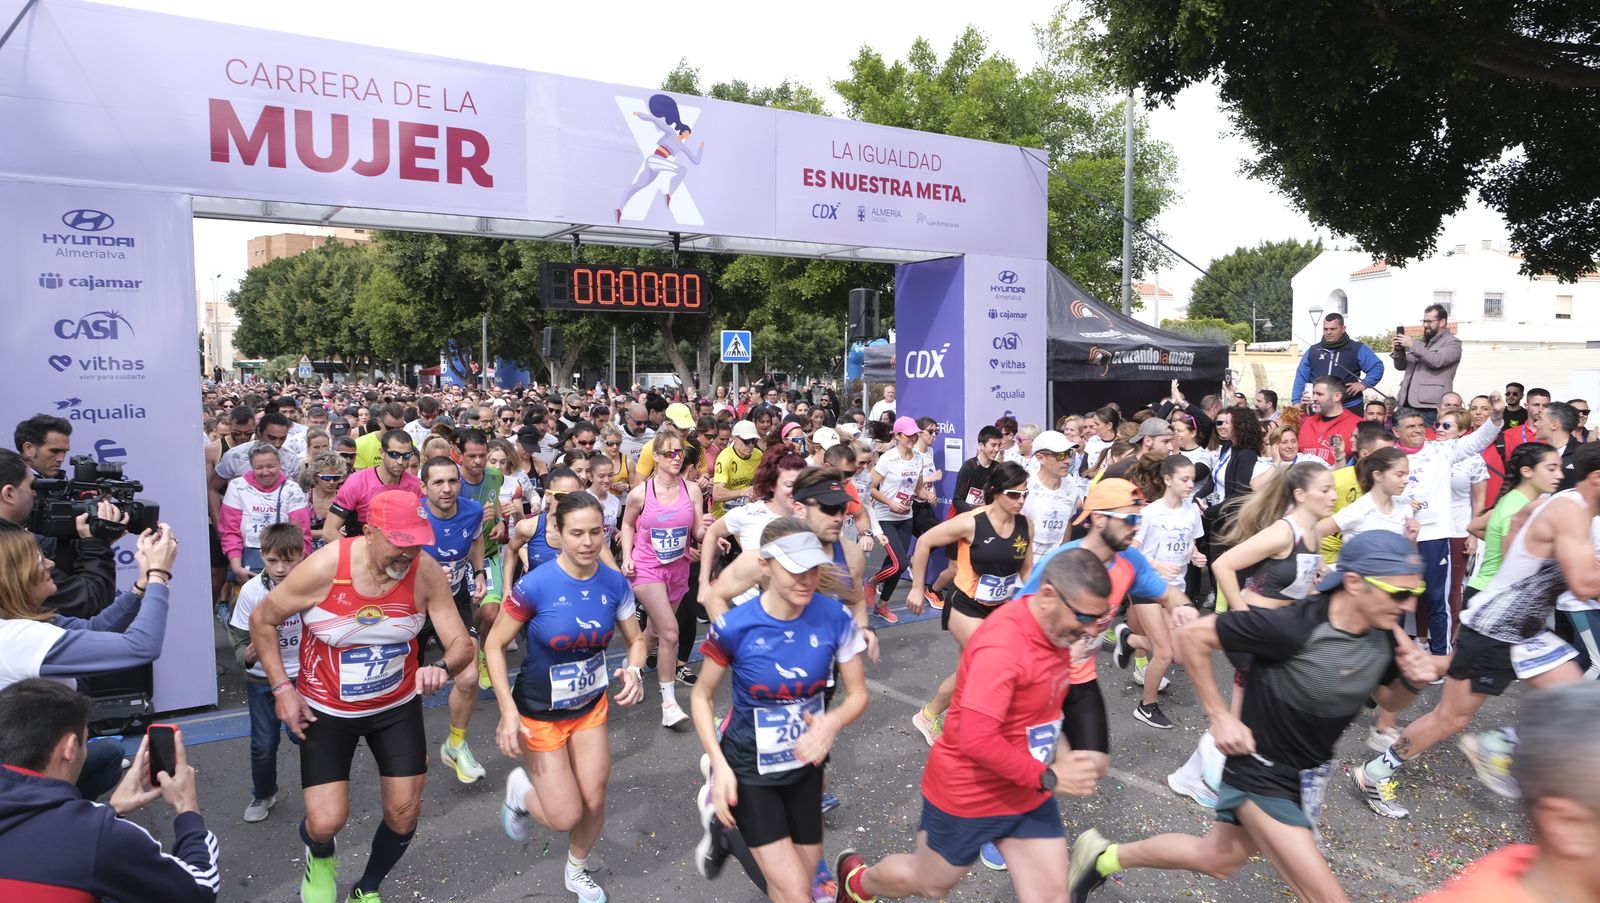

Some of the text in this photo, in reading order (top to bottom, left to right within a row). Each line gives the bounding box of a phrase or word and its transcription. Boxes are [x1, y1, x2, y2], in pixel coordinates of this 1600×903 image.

[225, 58, 478, 115] CARRERA DE LA
[208, 97, 494, 188] MUJER
[832, 140, 942, 172] LA IGUALDAD
[803, 168, 967, 203] ES NUESTRA META.
[812, 202, 841, 220] CDX
[871, 207, 902, 218] ALMERÍA
[42, 233, 135, 248] HYUNDAI
[55, 247, 126, 260] Almerialva
[68, 275, 144, 291] cajamar
[573, 268, 700, 308] 00:00:00
[990, 285, 1026, 294] HYUNDAI
[999, 310, 1028, 320] cajamar
[54, 318, 119, 340] CASI
[992, 336, 1018, 350] CASI
[78, 356, 145, 371] vithas
[904, 342, 951, 379] CDX
[1000, 360, 1026, 369] vithas
[995, 388, 1026, 401] aqualia
[69, 403, 146, 424] aqualia
[1042, 519, 1064, 530] 1023
[659, 537, 680, 549] 115
[988, 586, 1009, 597] 105
[364, 660, 389, 677] 77
[568, 672, 596, 692] 190
